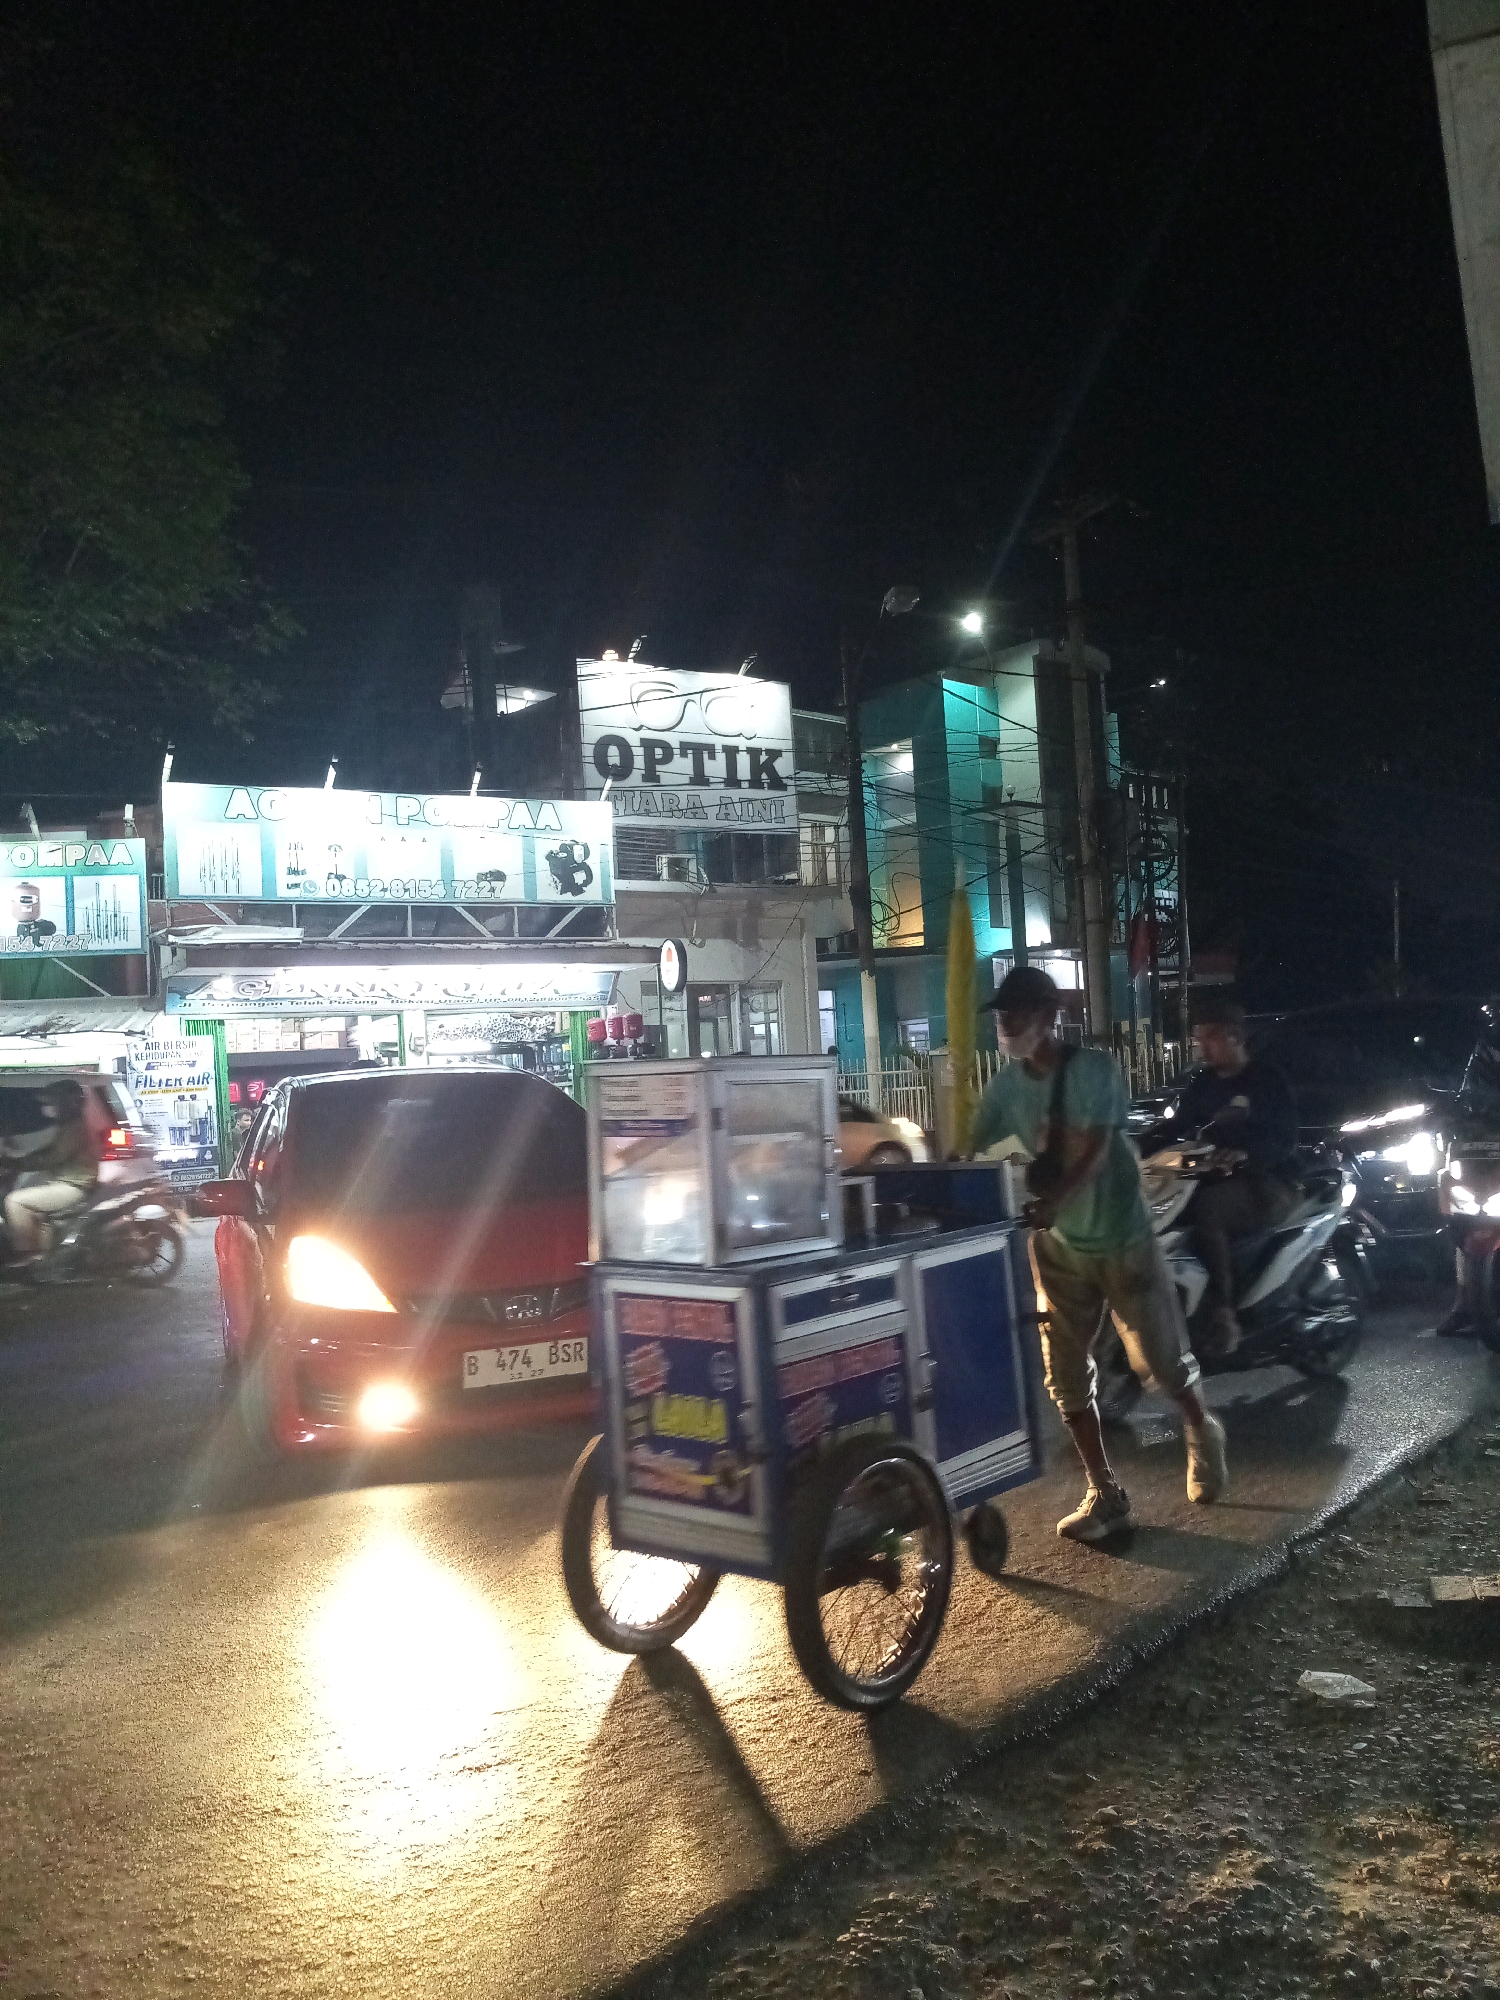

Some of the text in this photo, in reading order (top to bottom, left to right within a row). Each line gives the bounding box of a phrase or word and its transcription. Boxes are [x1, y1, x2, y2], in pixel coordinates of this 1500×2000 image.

[593, 734, 788, 791] OPTIK
[396, 795, 563, 831] POMPAA
[604, 790, 785, 823] TIARA AINI
[145, 1041, 160, 1051] AIR
[186, 1071, 212, 1086] AIR
[467, 1341, 585, 1376] B 474 BSR
